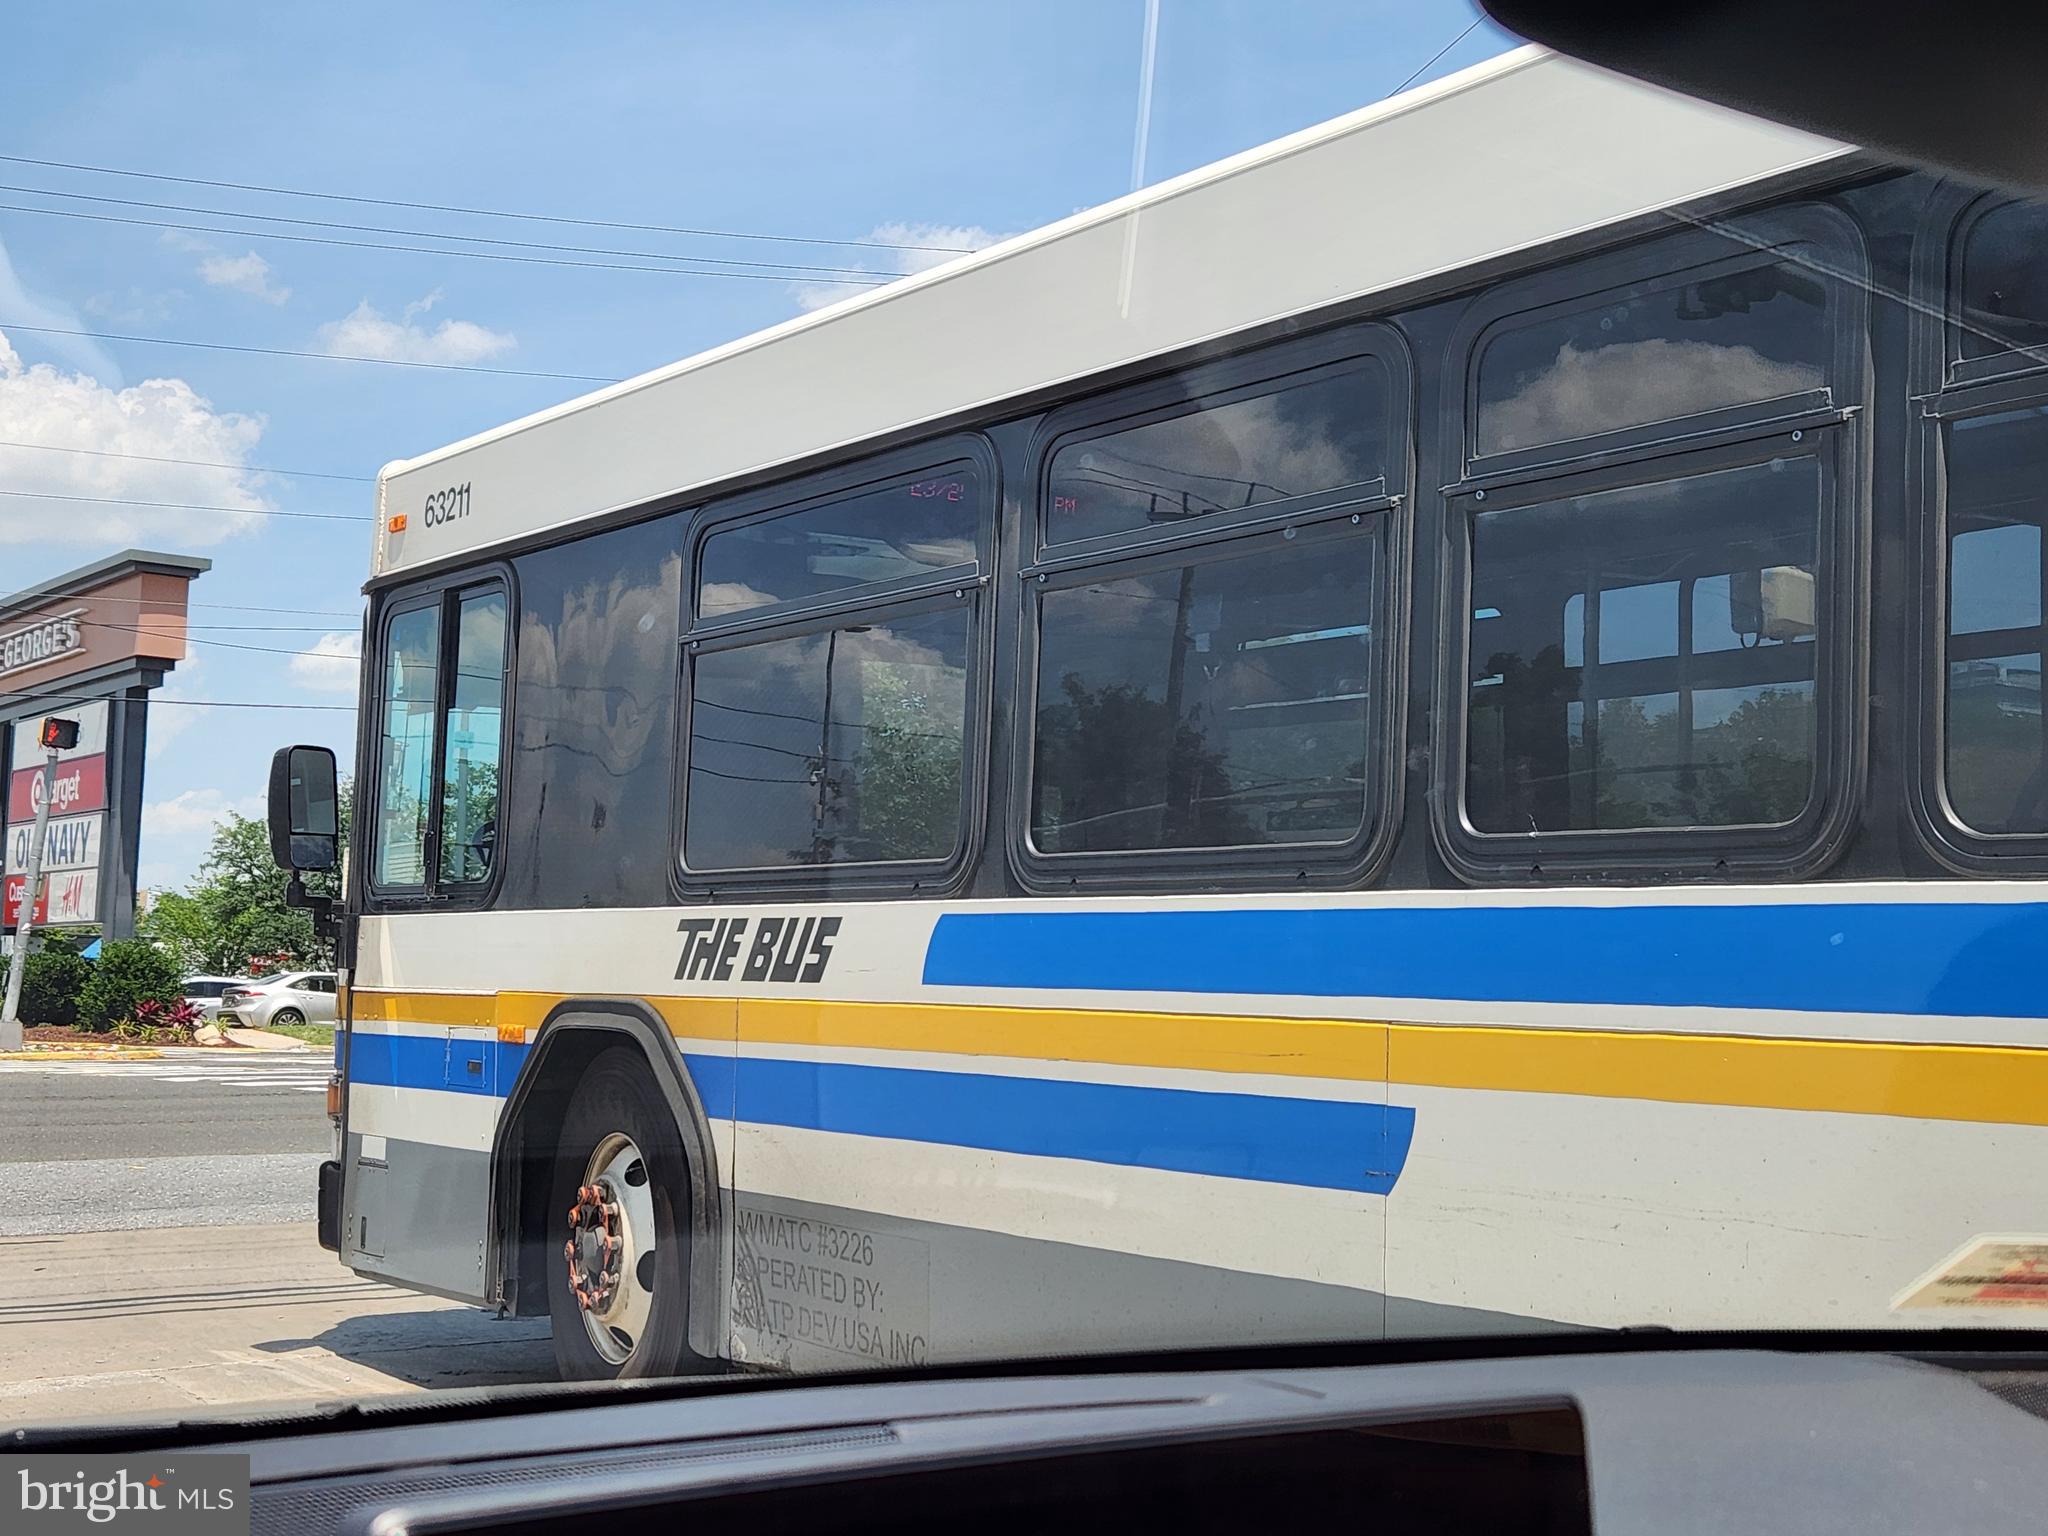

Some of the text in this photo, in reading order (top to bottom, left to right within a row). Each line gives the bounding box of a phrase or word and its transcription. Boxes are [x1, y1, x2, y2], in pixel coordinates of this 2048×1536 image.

[425, 481, 471, 528] 63211
[49, 769, 81, 810] arget
[47, 820, 91, 867] NAVY
[674, 916, 843, 983] THE BUS
[739, 1210, 874, 1267] WMATC #3226
[749, 1255, 884, 1313] PERATED BY:
[843, 1315, 885, 1358] USA
[889, 1327, 927, 1366] INC
